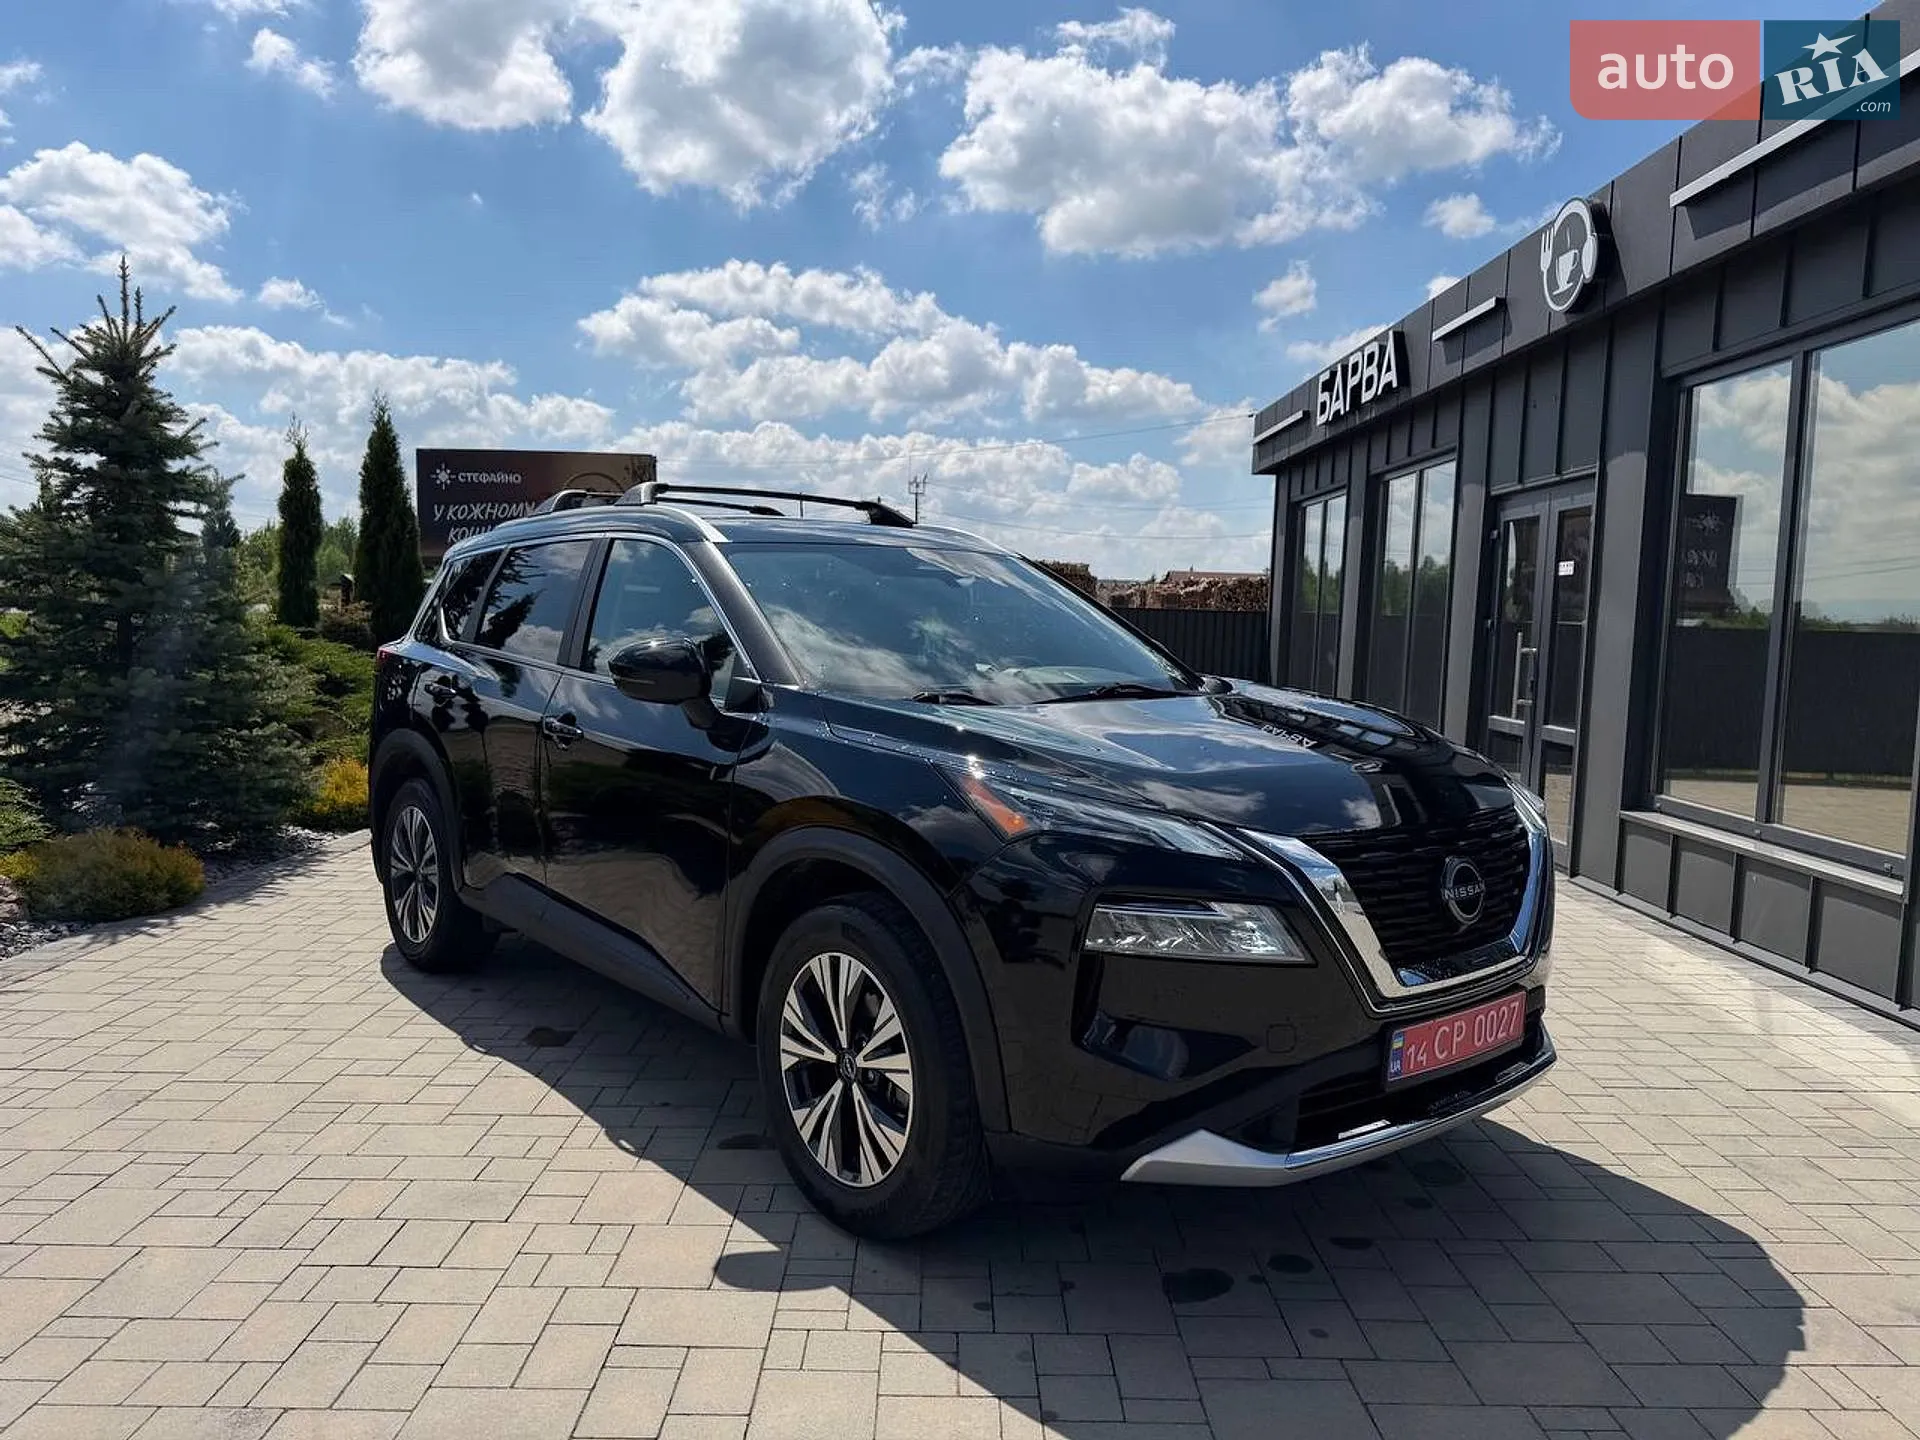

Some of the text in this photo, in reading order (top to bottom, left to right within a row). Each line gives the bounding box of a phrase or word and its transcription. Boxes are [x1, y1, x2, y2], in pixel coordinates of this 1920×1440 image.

[1317, 329, 1398, 426] БАРВА
[458, 471, 522, 484] СТЕФАЙНО
[1407, 1041, 1427, 1069] 14
[1474, 1001, 1520, 1048] 0027
